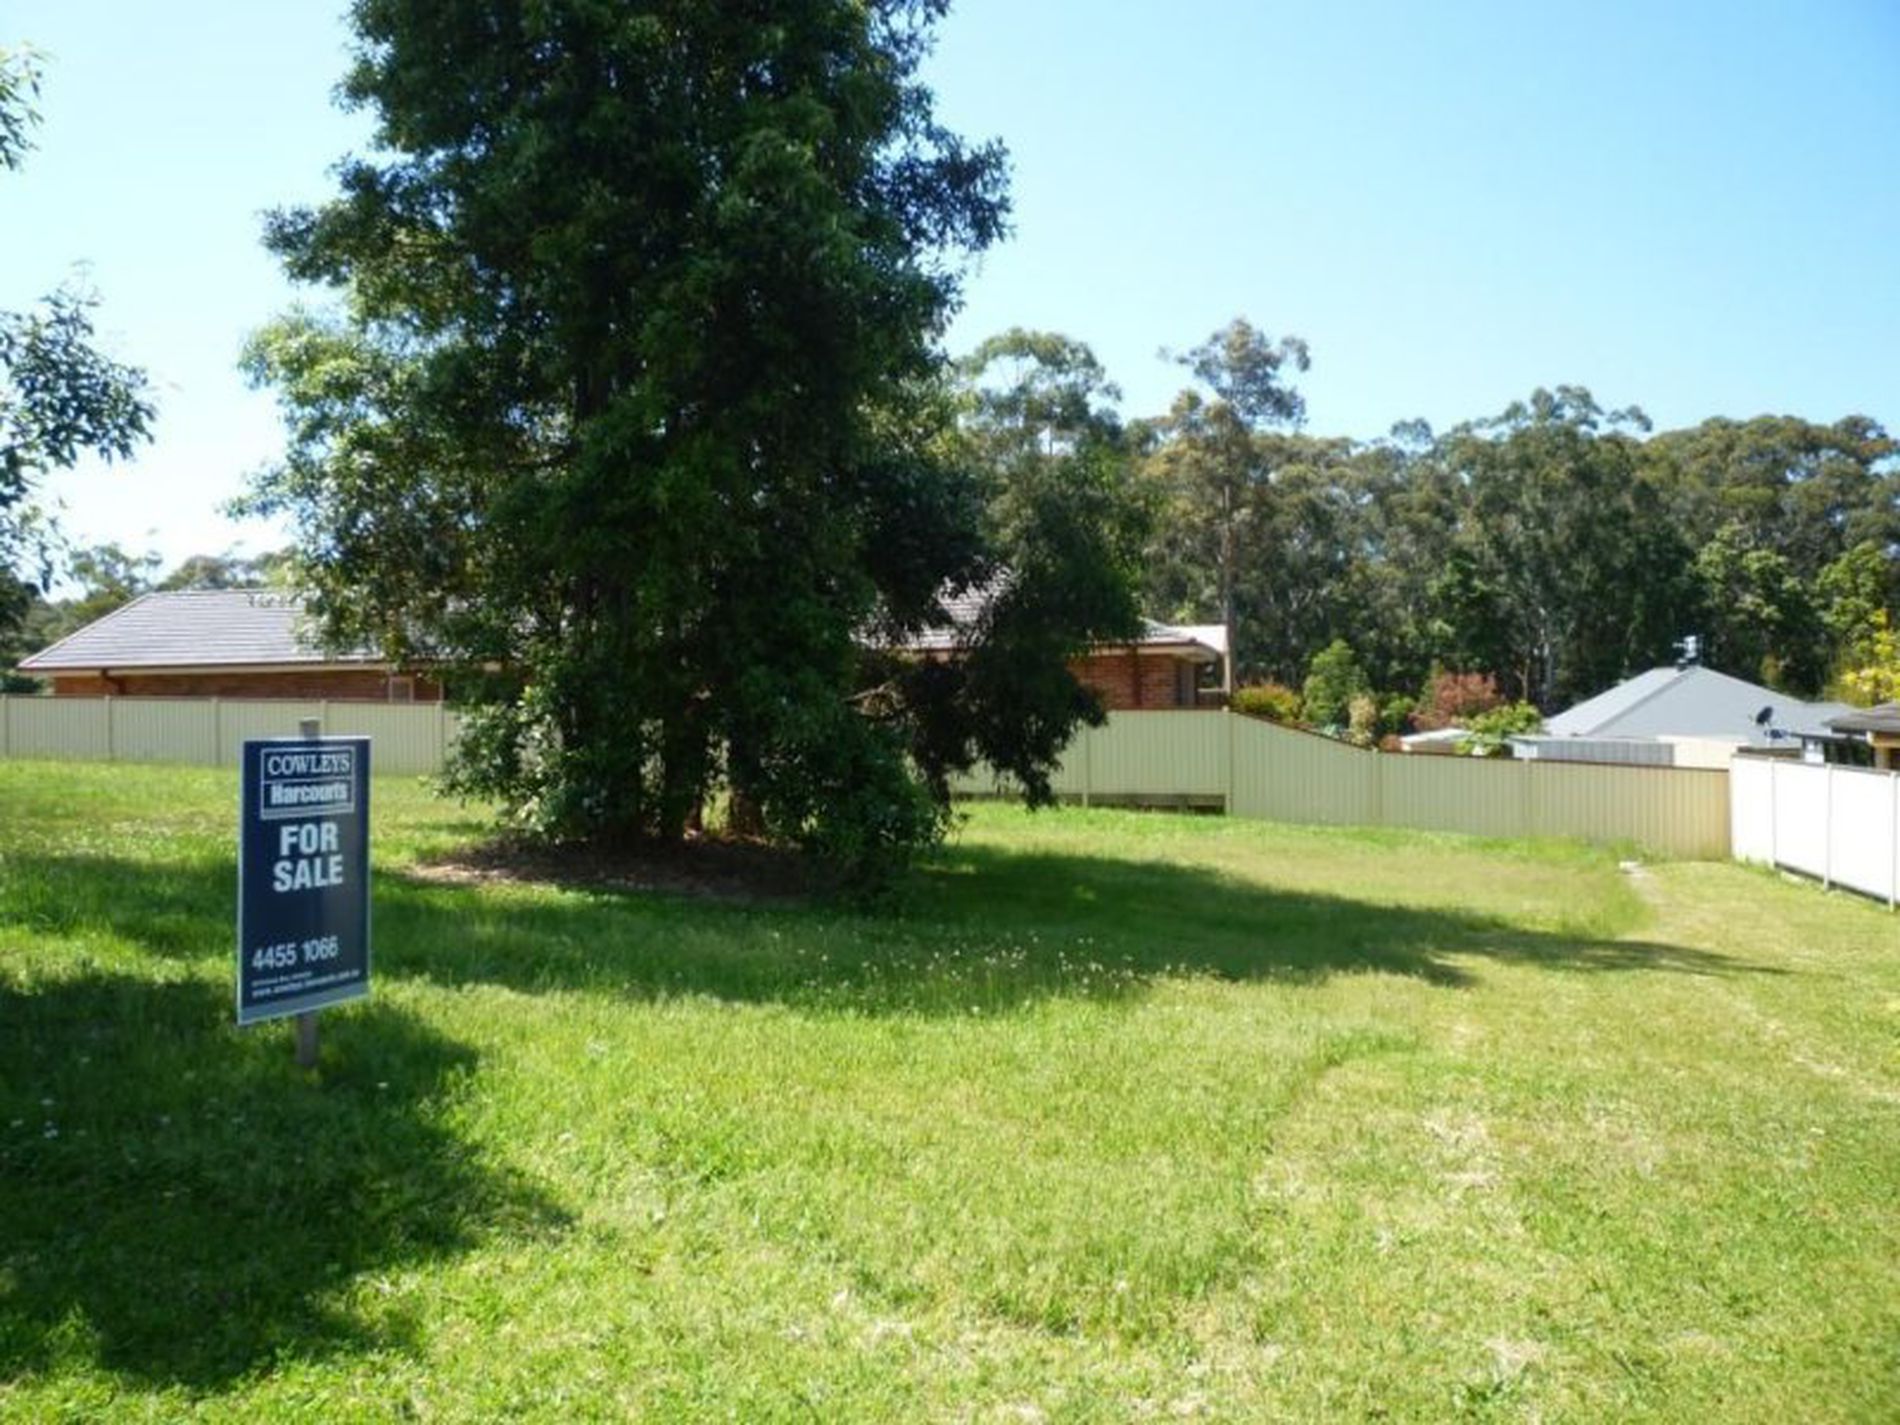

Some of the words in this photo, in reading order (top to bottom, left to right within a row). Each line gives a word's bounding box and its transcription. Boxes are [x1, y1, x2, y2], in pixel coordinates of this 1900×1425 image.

[268, 754, 350, 775] COWLEYS
[270, 782, 348, 805] Harcourts
[280, 822, 339, 856] FOR
[273, 855, 343, 892] SALE
[252, 942, 297, 969] 4455
